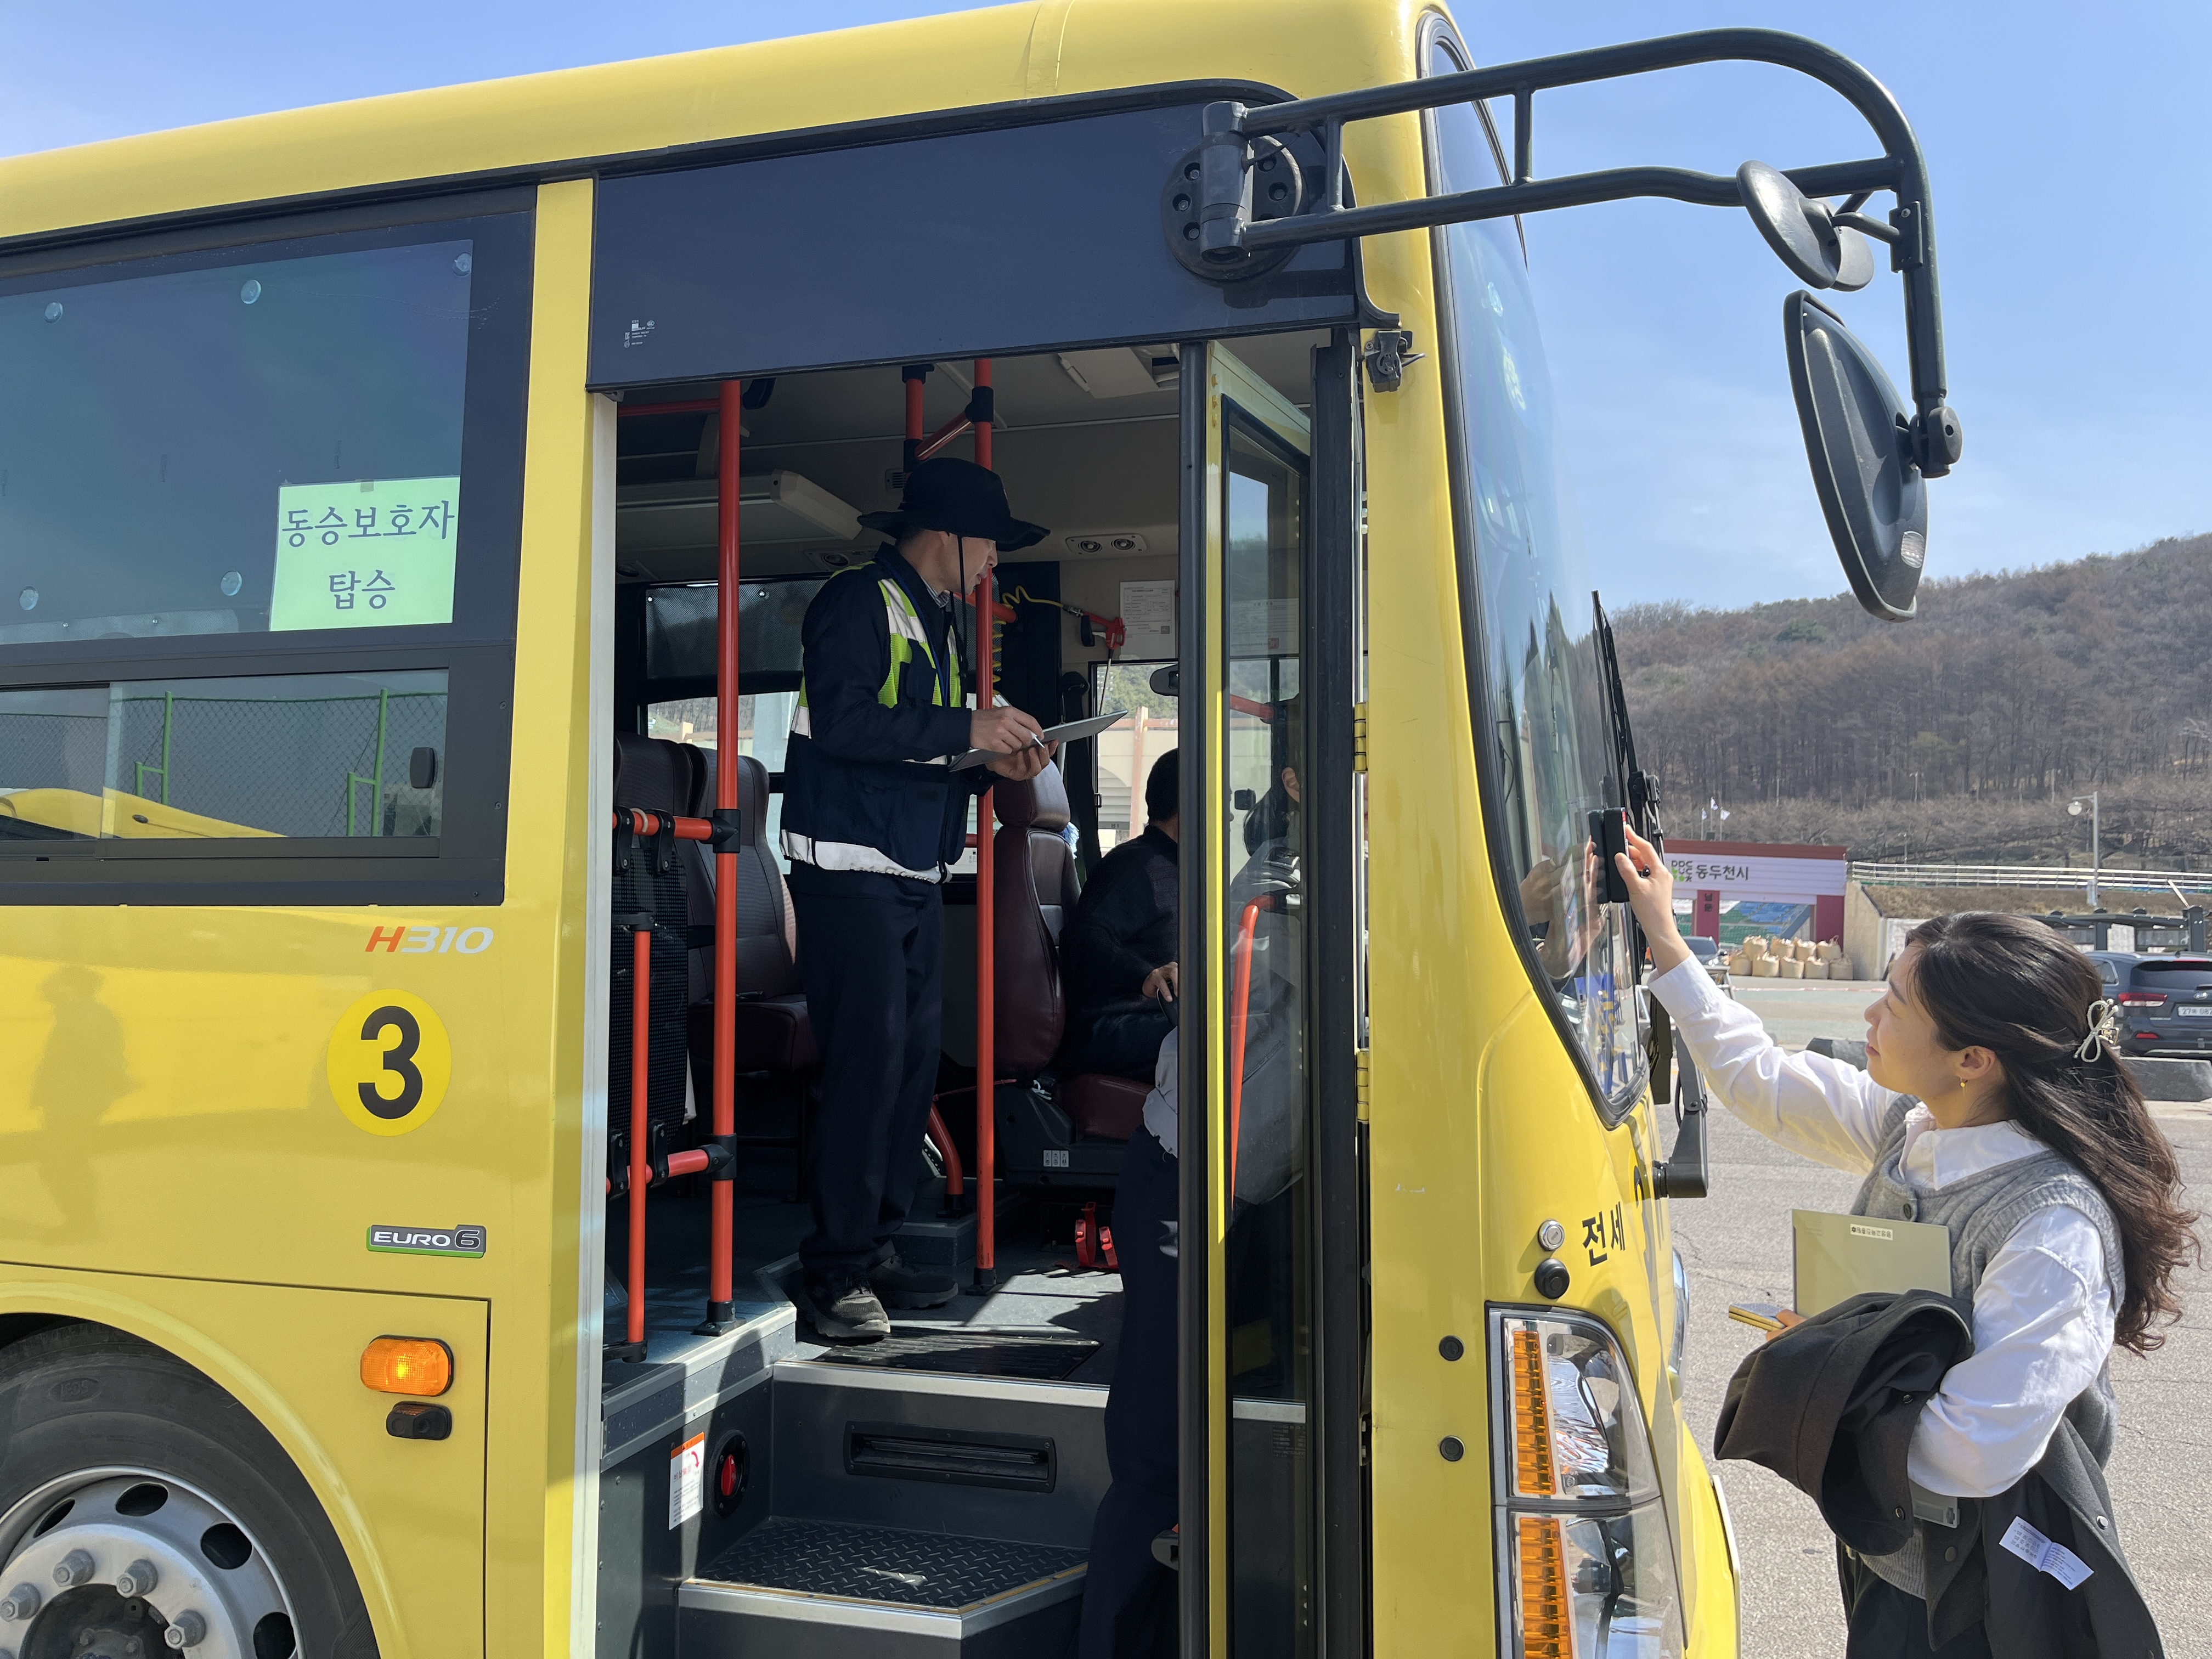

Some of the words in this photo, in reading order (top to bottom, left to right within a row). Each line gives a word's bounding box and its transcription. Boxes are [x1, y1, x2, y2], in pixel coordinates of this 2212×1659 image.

[281, 500, 455, 548] 동승보호자
[329, 569, 396, 610] 탑승
[1696, 864, 1749, 881] 동두천시
[364, 926, 494, 953] H310
[358, 1005, 423, 1120] 3
[1582, 1201, 1626, 1267] 전세
